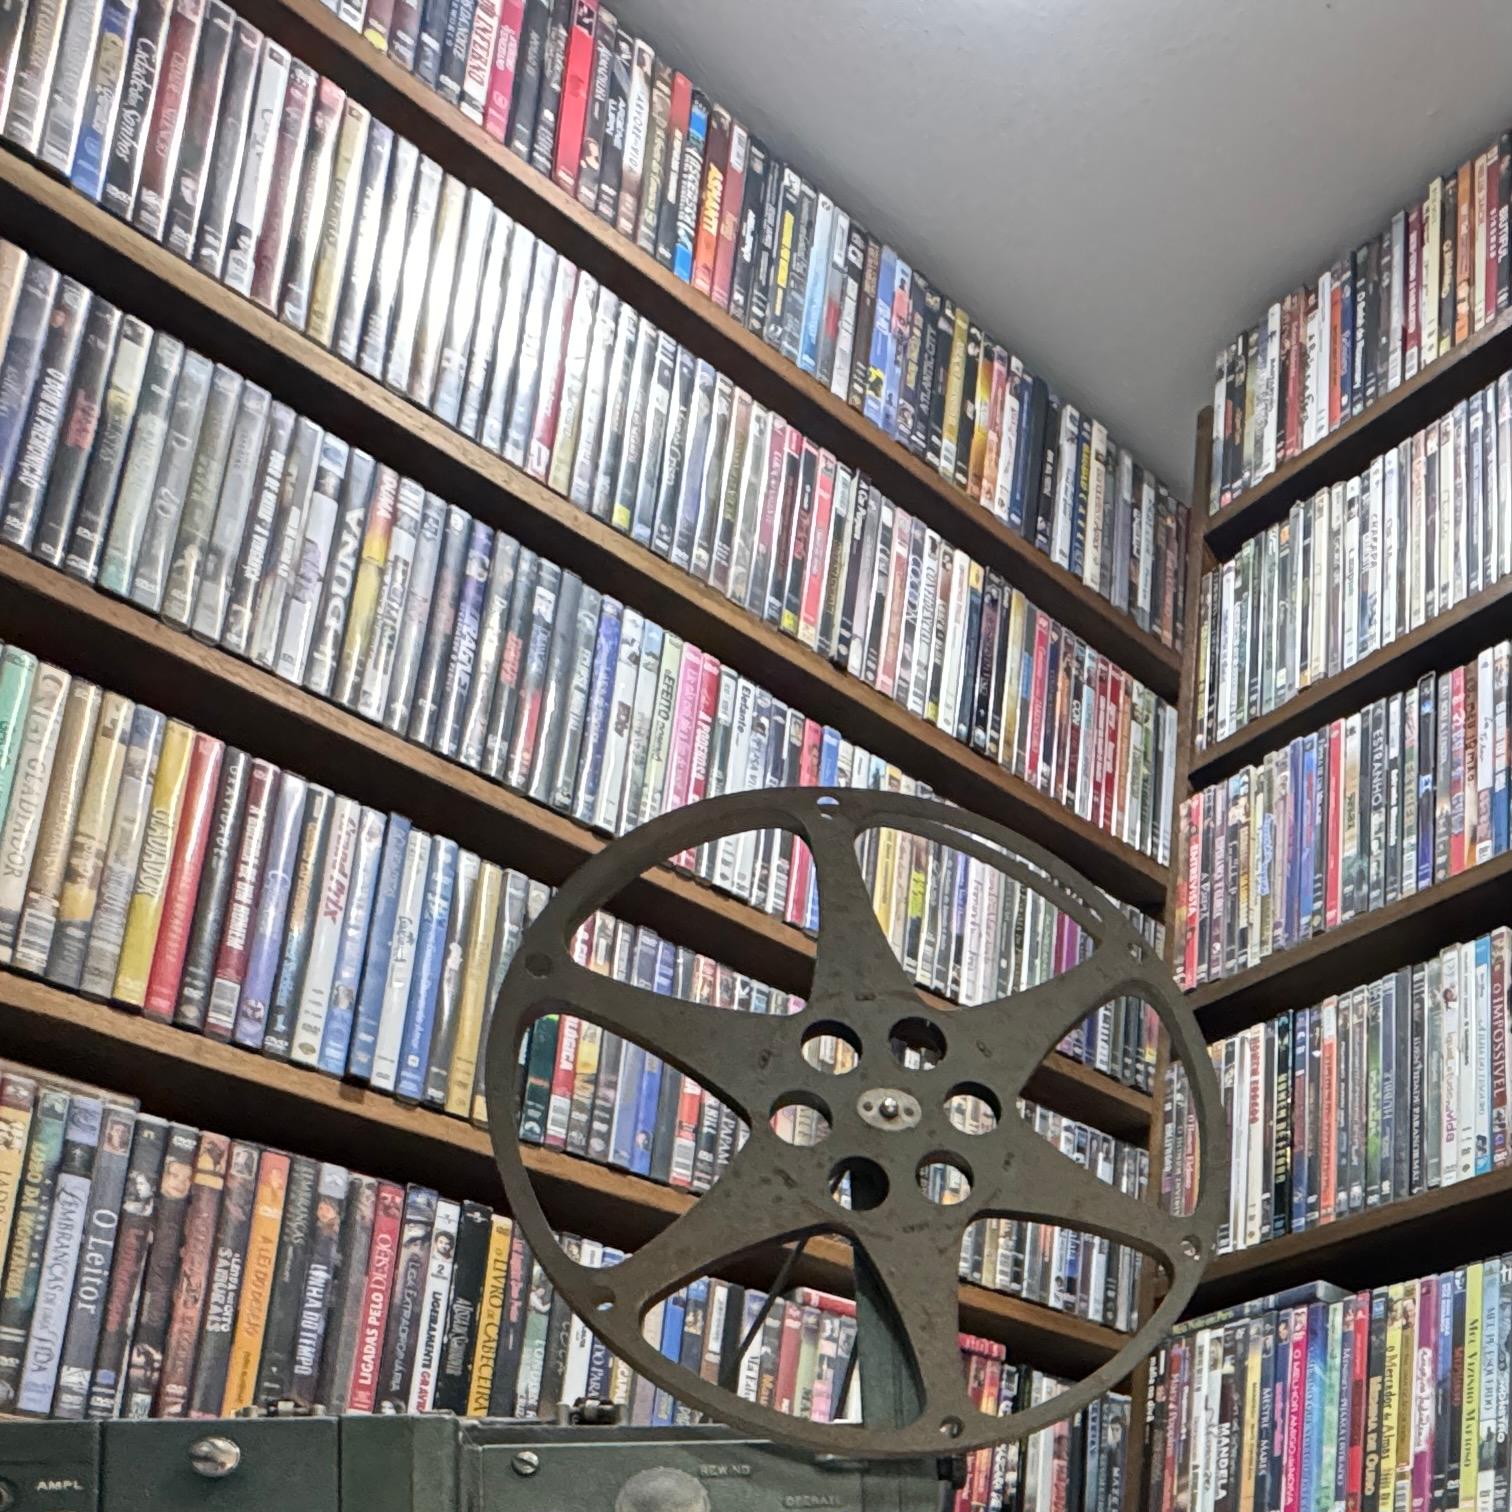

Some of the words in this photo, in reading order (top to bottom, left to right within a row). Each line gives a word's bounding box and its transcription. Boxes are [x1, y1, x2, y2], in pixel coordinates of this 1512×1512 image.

[326, 507, 365, 631] DUNA
[1371, 729, 1384, 806] ESTRANHO
[136, 806, 173, 898] GLADIADOR
[1188, 843, 1198, 918] ENTREVISTA
[1492, 998, 1506, 1098] IMPOSSÍVEL
[47, 1185, 81, 1290] LEMBRANÇAS
[92, 1209, 118, 1229] O
[77, 1235, 114, 1315] Leitor
[301, 1264, 330, 1308] LINHA
[488, 1259, 508, 1309] LIVRO
[294, 1332, 319, 1375] TEMPO
[301, 1311, 321, 1330] DO
[359, 1328, 378, 1384] LIGADAS
[369, 1292, 382, 1325] PELO
[421, 1291, 443, 1369] LIGEIRAMENTE
[473, 1322, 500, 1412] CABECEIRA
[37, 1479, 84, 1491] AMPL
[1216, 1422, 1230, 1500] MANDELA
